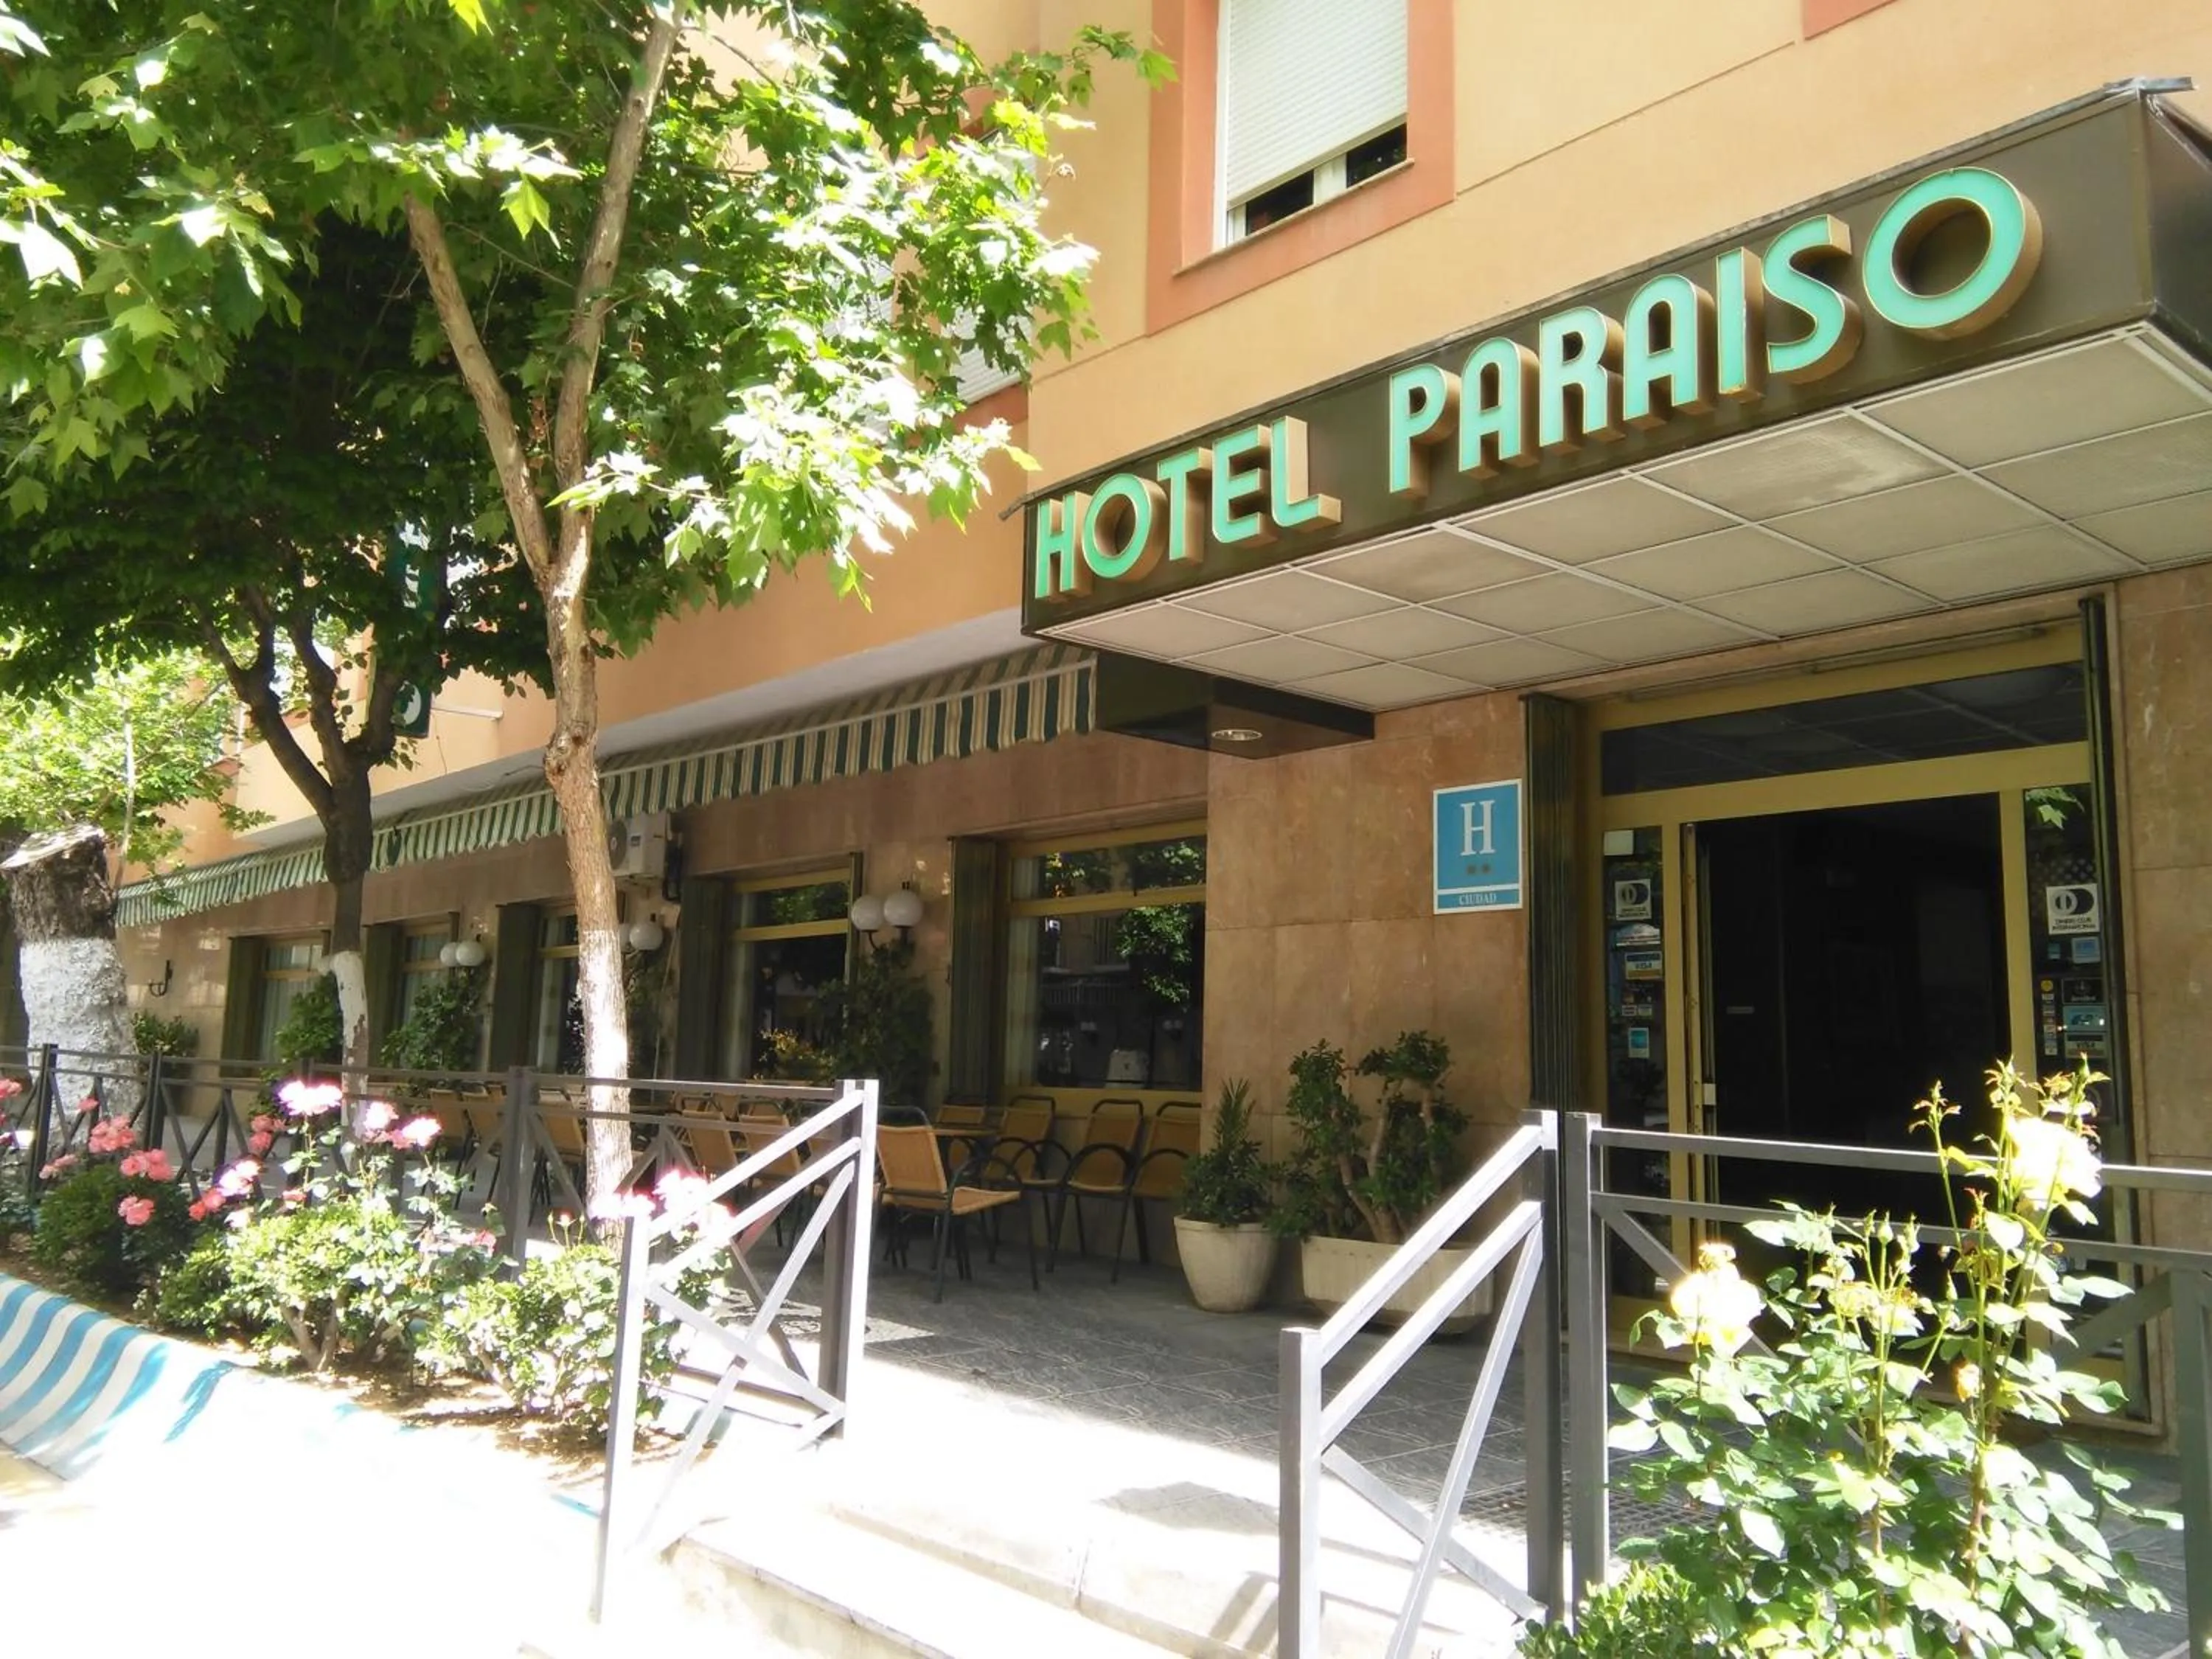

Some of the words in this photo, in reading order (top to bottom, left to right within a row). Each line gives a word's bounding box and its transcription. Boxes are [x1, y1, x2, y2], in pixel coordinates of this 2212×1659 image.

[1034, 415, 1333, 599] HOTEL
[1389, 167, 2034, 493] PARAISO
[1460, 799, 1496, 856] H
[1458, 893, 1498, 905] CIUDAD
